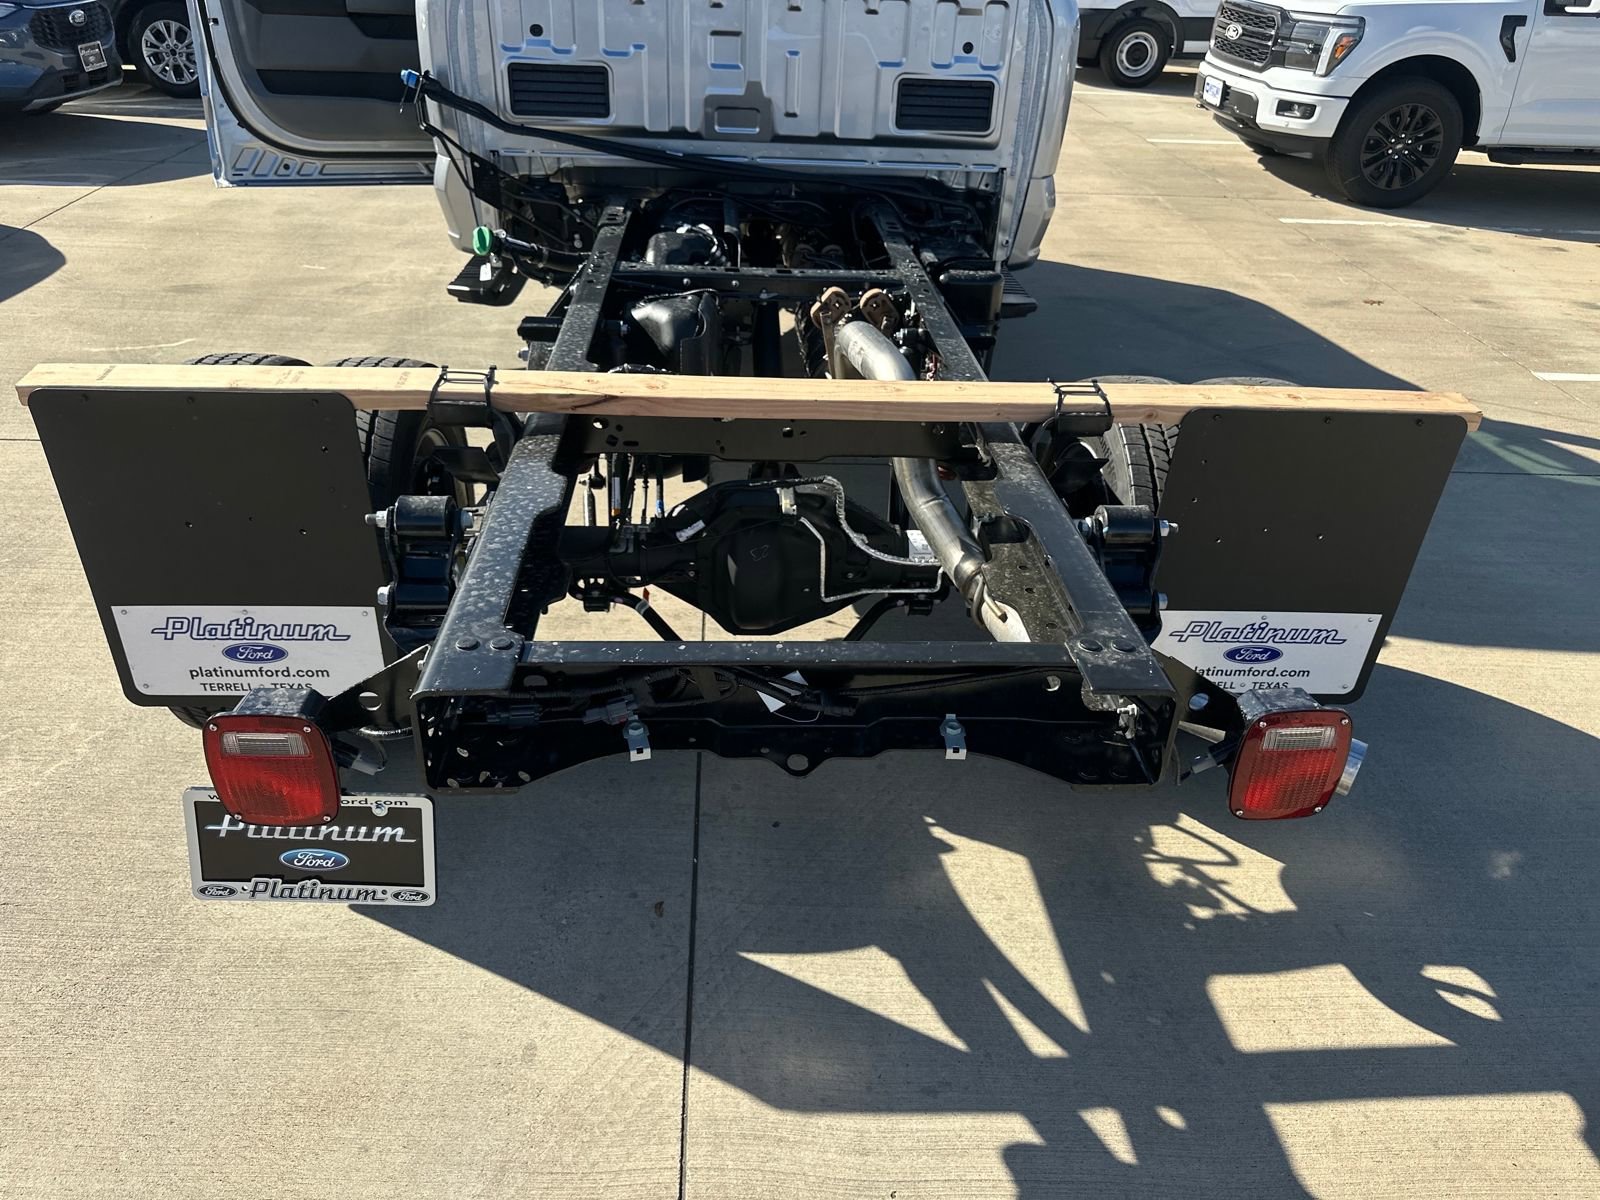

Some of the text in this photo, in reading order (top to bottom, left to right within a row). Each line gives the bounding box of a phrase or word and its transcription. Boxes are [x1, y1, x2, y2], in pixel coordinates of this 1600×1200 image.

[151, 616, 351, 641] Platinum
[1169, 620, 1348, 645] Platinum
[236, 645, 275, 659] Ford
[1235, 647, 1272, 660] Ford
[189, 666, 330, 680] platinumford.com
[1194, 666, 1310, 678] latinumford.com
[1252, 681, 1289, 690] TEXAS
[294, 851, 336, 867] Ford
[204, 880, 424, 901] Ford Platinum Ford
